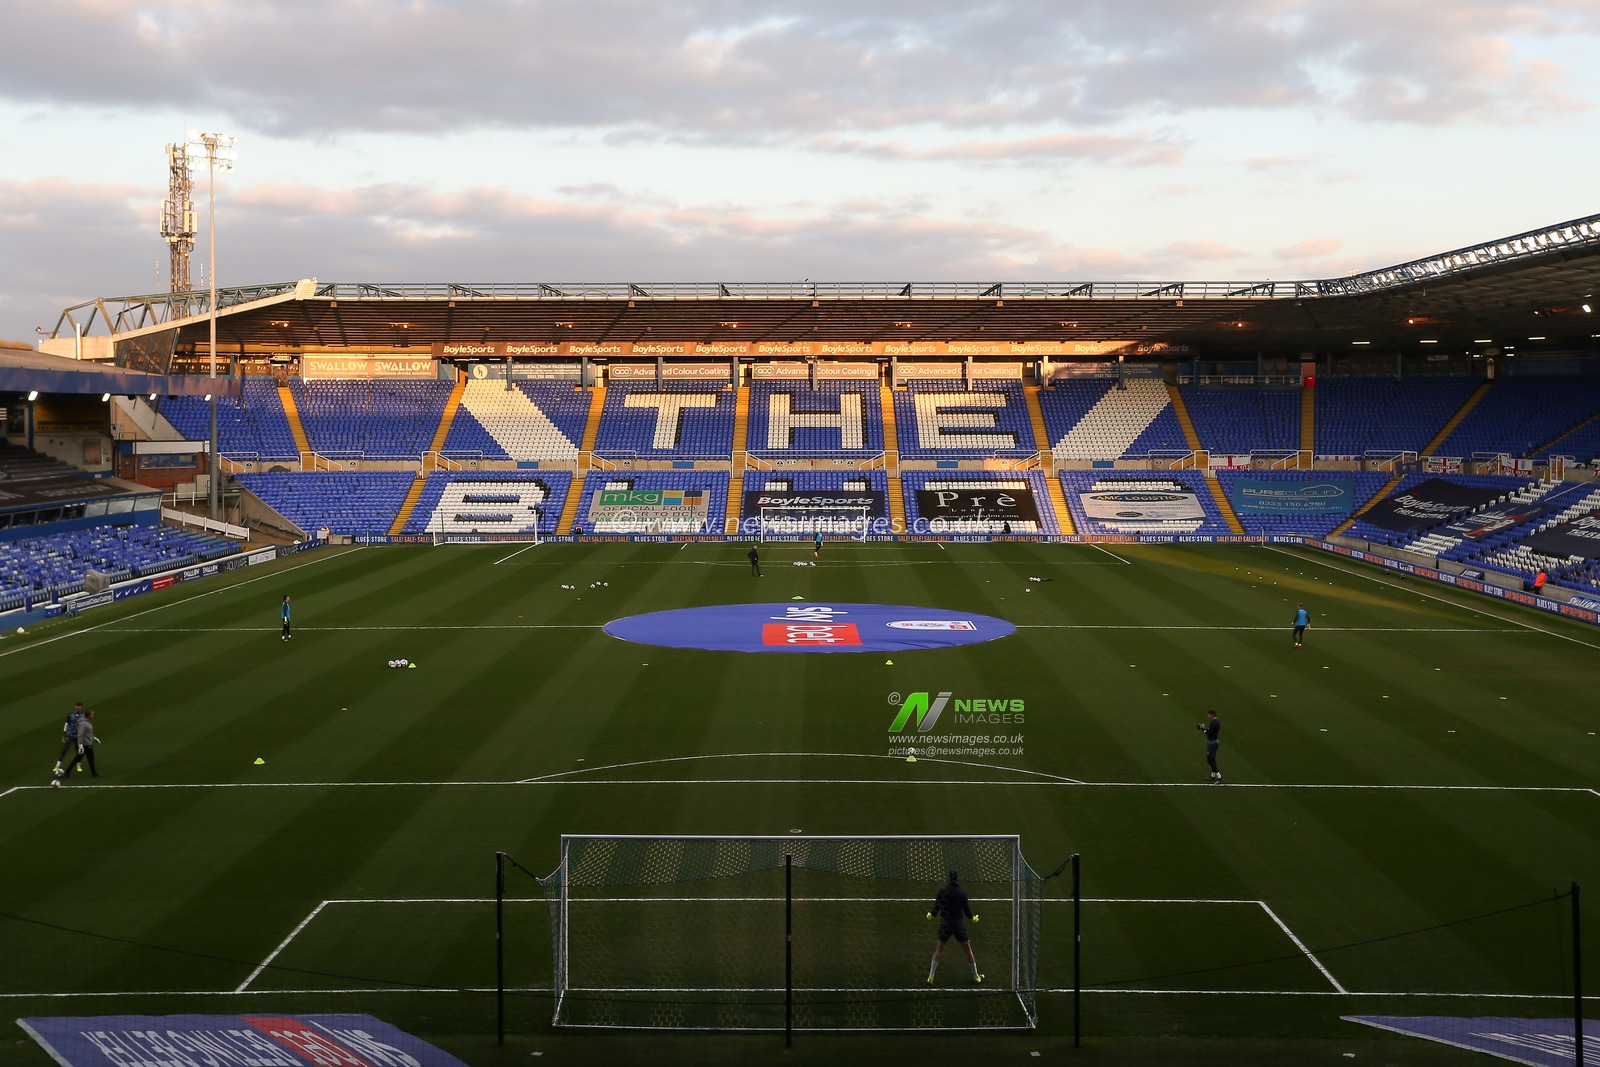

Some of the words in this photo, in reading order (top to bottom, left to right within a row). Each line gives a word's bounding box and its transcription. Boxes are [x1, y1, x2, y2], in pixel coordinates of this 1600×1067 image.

[444, 345, 495, 354] BoyleSports
[507, 345, 558, 354] BoyleSports
[570, 345, 621, 354] BoyleSports
[633, 345, 684, 354] BoyleSports
[696, 345, 747, 354] BoyleSports
[759, 345, 810, 354] BoyleSports
[822, 345, 873, 353] BoyleSports
[885, 345, 936, 353] BoyleSports
[948, 345, 999, 353] BoyleSports
[1011, 345, 1062, 353] BoyleSports
[1075, 345, 1125, 353] BoyleSports
[310, 362, 368, 370] SWALLOW
[375, 362, 431, 370] SWALLOW
[623, 392, 1018, 450] THE
[604, 491, 659, 504] mkg
[757, 497, 874, 506] BoyleSports
[770, 606, 848, 622] sky
[786, 625, 847, 643] bet
